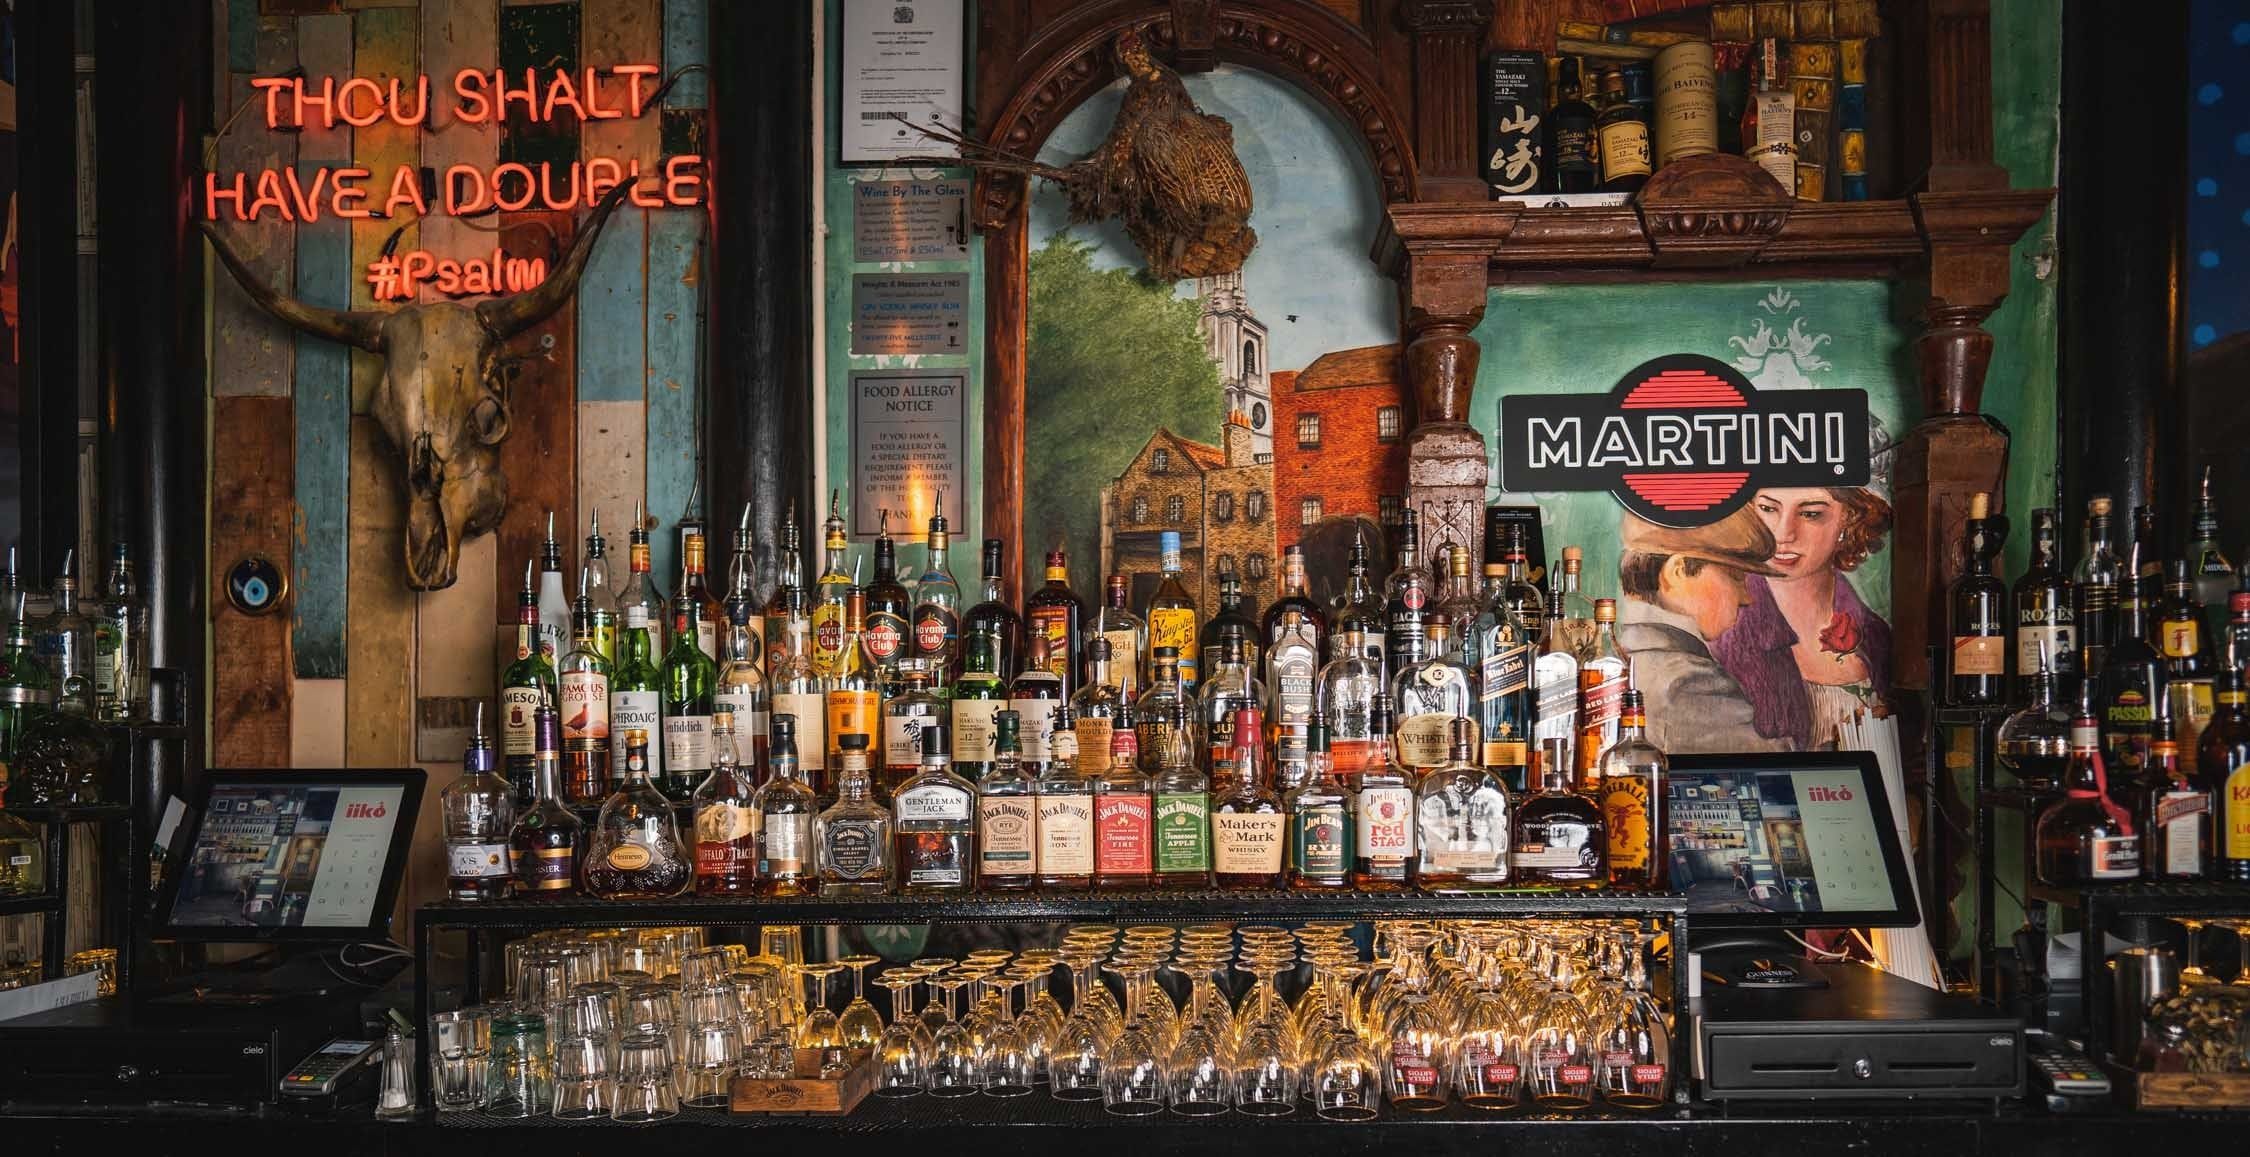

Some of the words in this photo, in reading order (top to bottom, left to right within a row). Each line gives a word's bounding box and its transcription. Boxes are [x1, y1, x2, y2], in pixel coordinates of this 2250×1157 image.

[252, 75, 429, 129] THOU
[454, 64, 658, 123] SHALT
[206, 165, 371, 223] HAVE
[386, 165, 428, 217] A
[862, 186, 889, 198] Wine
[893, 185, 906, 198] By
[912, 184, 930, 196] The
[936, 184, 965, 196] Glass
[367, 249, 545, 301] #Psalm
[864, 386, 899, 397] FOOD
[903, 385, 956, 397] ALLERGY
[886, 400, 934, 412] NOTICE
[890, 432, 907, 440] YOU
[909, 432, 930, 440] HAVE
[1528, 411, 1845, 468] MARTINI
[865, 464, 923, 472] REQUIREMENT
[916, 623, 947, 634] Havana
[1152, 615, 1194, 645] Kingston
[866, 630, 901, 641] Havana
[920, 634, 940, 644] Club
[871, 640, 893, 650] Club
[1504, 659, 1524, 674] Label
[1586, 700, 1603, 709] RED
[2108, 706, 2151, 721] PASSO
[965, 733, 973, 741] 12
[906, 796, 962, 806] GENTLEMAN
[923, 805, 945, 813] JACK
[983, 806, 1000, 821] JACK
[1100, 804, 1119, 820] JACK
[1157, 803, 1176, 820] JACK
[1219, 819, 1276, 830] Maker's
[1305, 815, 1321, 831] JIM
[1321, 813, 1343, 831] BEAM
[1371, 821, 1404, 837] red
[1235, 832, 1275, 842] Mark
[1370, 836, 1406, 847] STAG
[614, 853, 643, 861] Hennessy
[243, 1045, 264, 1055] cielo
